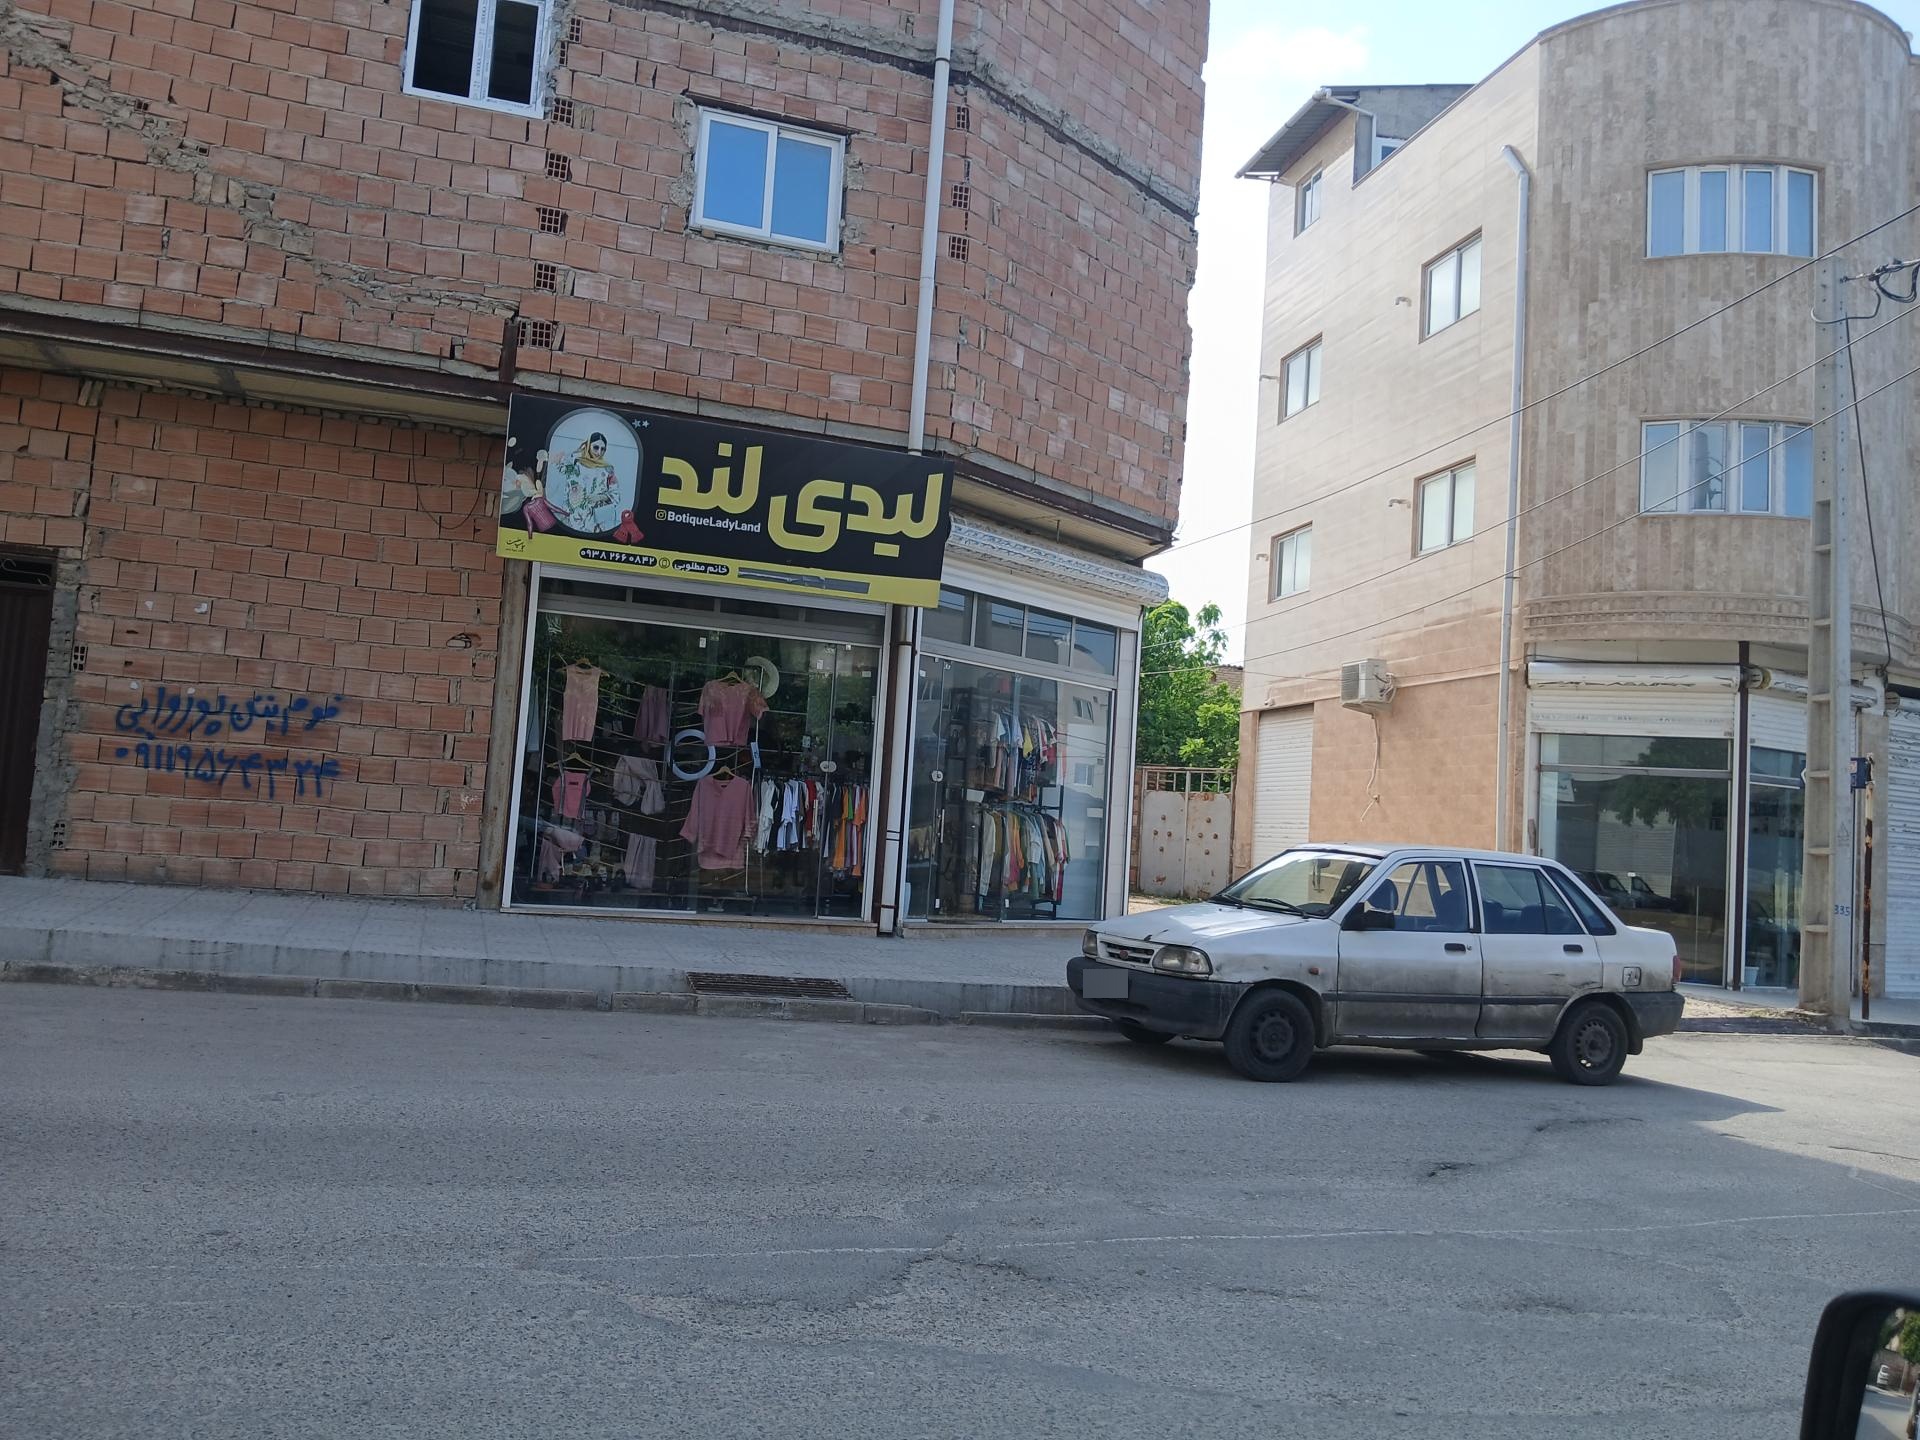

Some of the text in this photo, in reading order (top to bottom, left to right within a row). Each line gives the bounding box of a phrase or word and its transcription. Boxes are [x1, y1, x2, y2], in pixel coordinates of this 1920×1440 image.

[657, 442, 944, 558] لیدی لند
[667, 511, 761, 533] BotiqueLadyLand
[706, 565, 728, 574] خانم
